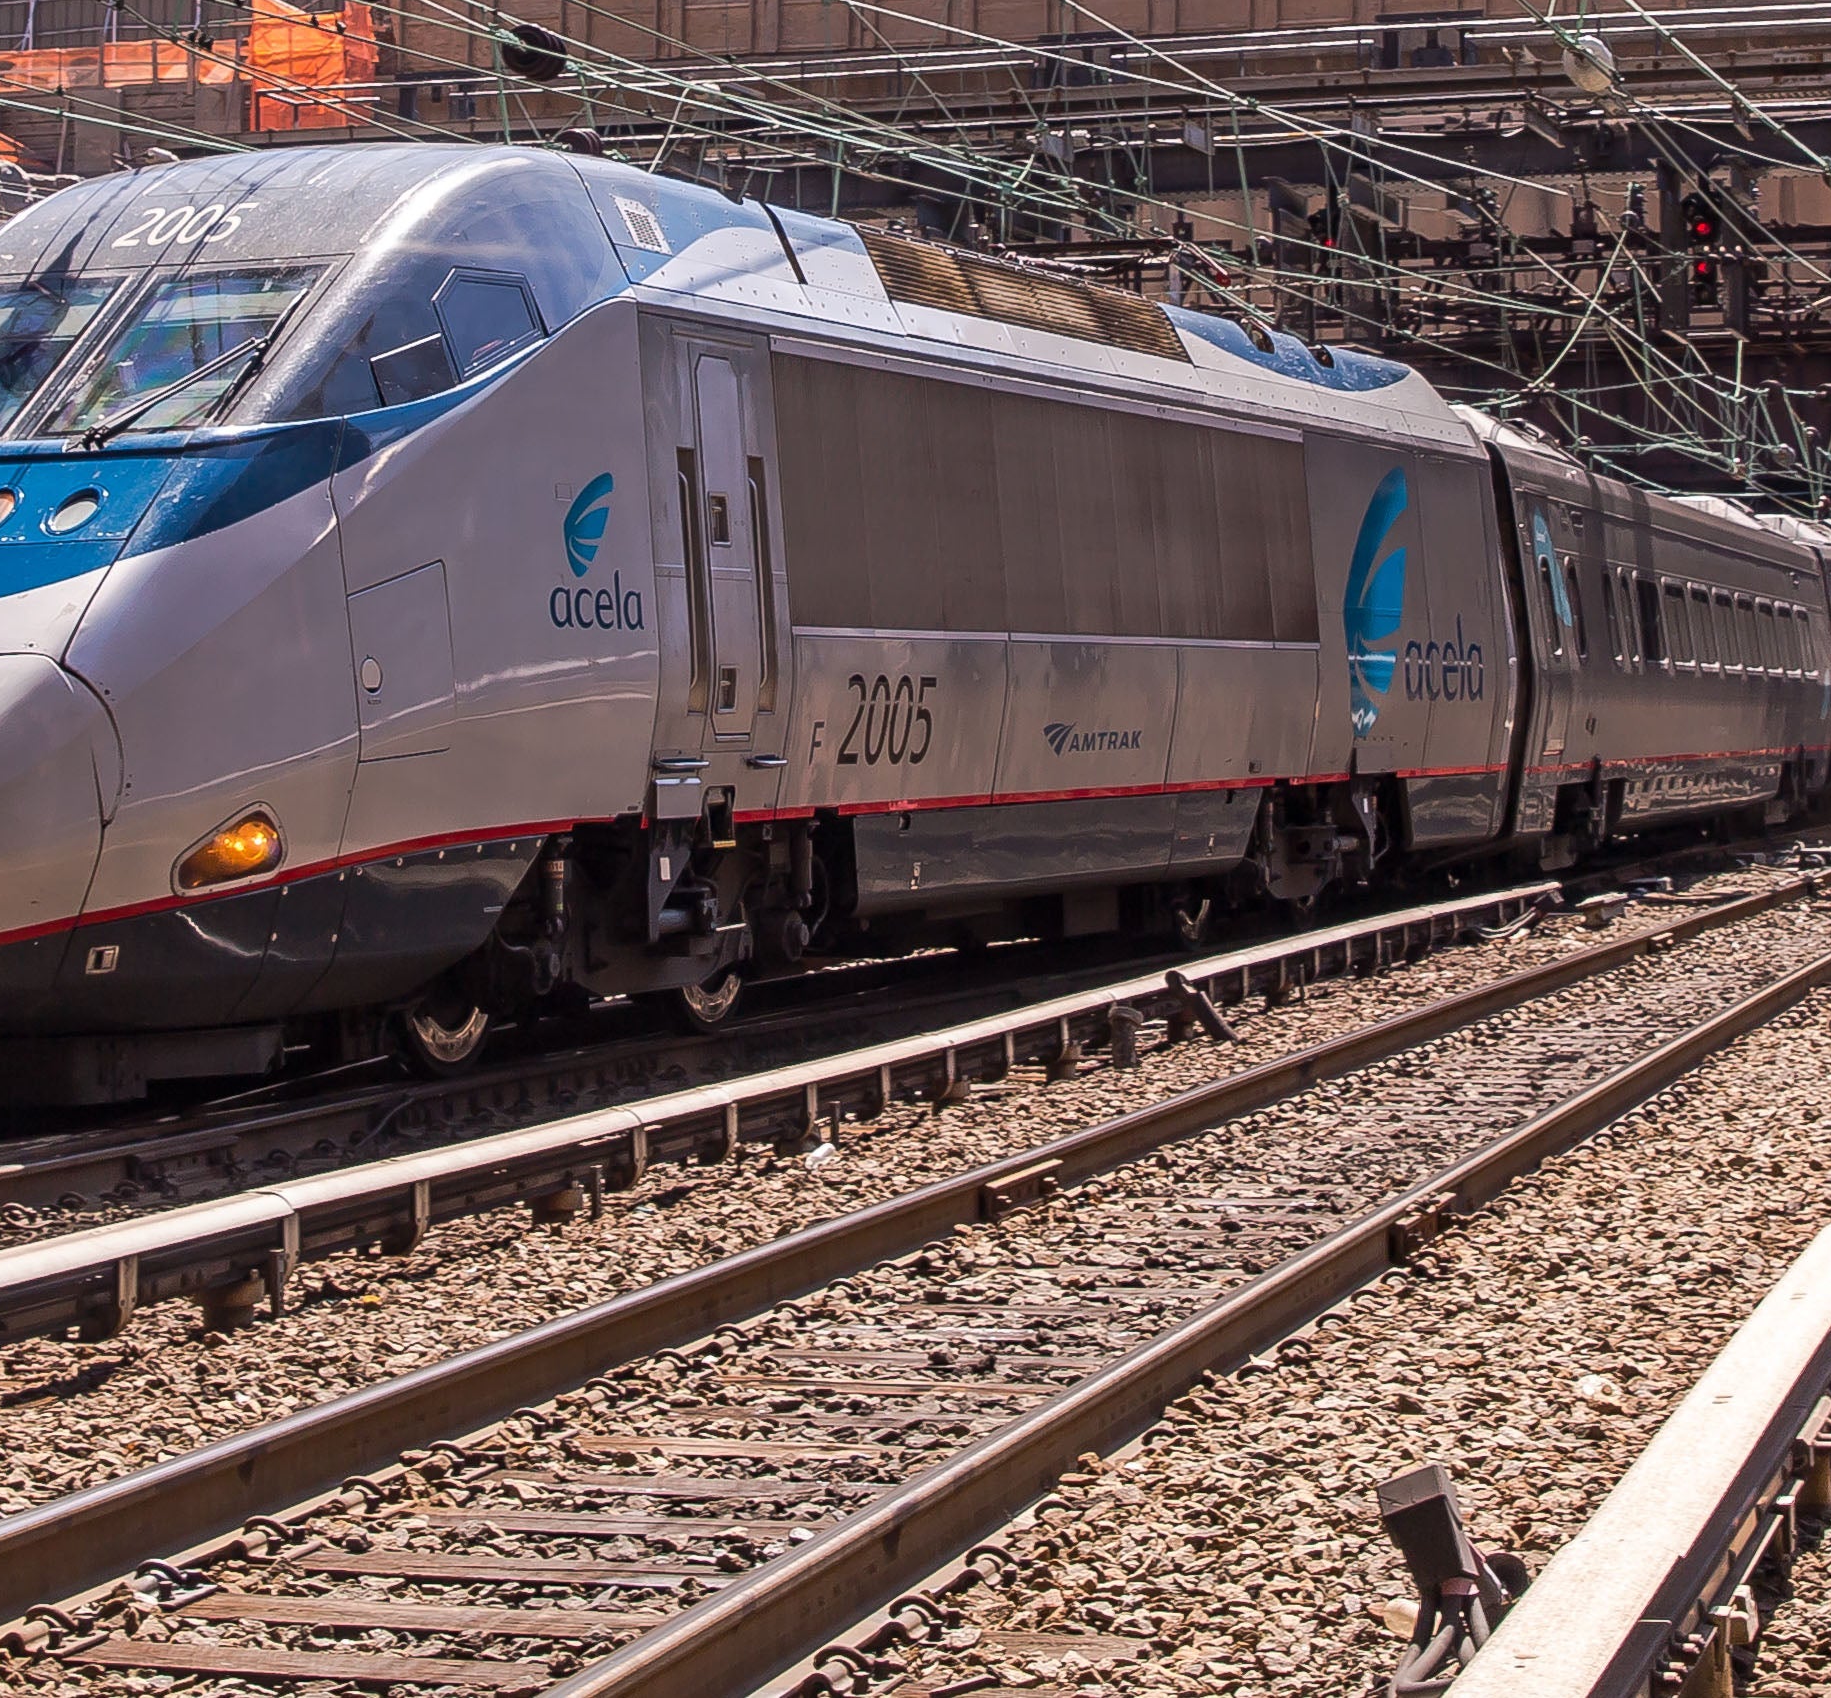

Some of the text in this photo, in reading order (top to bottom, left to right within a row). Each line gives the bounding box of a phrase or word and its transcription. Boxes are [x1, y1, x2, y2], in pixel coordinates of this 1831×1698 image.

[111, 202, 260, 249] 2005
[550, 569, 645, 631] acela
[1405, 613, 1485, 702] acela
[809, 673, 938, 765] F 2005
[1068, 730, 1143, 753] AMTRAK
